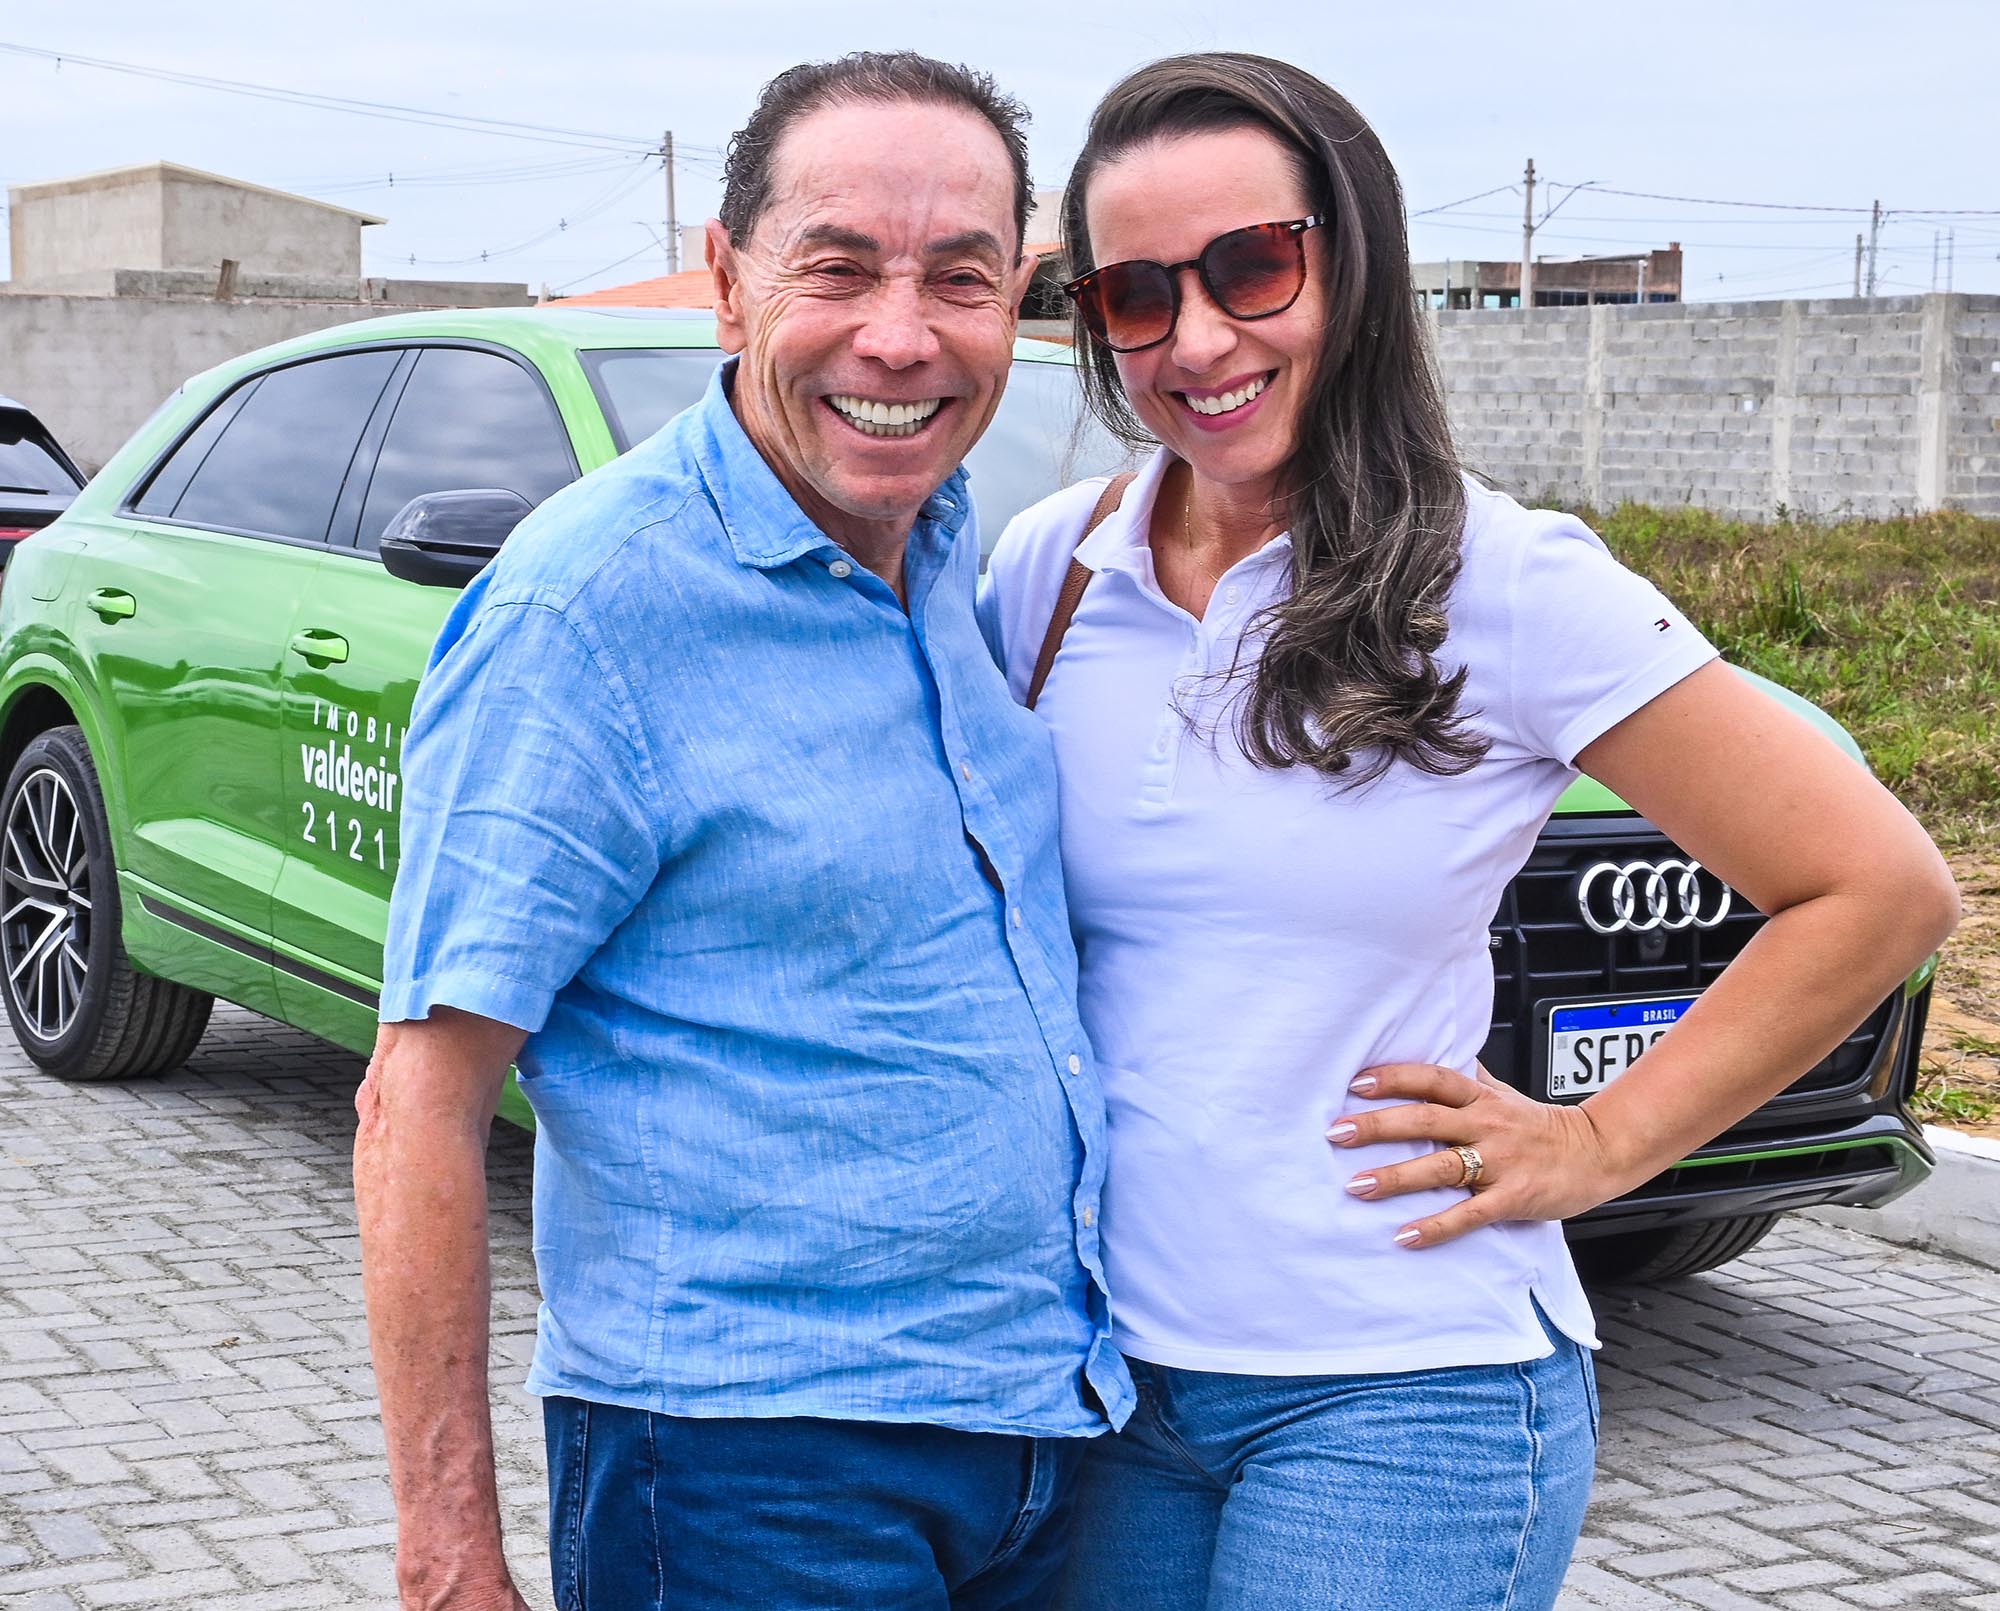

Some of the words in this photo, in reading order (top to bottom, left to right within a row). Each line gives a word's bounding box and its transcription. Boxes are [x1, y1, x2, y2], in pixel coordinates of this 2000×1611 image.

[301, 739, 397, 813] valdecir
[302, 801, 385, 870] 2121
[1643, 1008, 1677, 1022] BRASIL
[1553, 1075, 1566, 1090] BR
